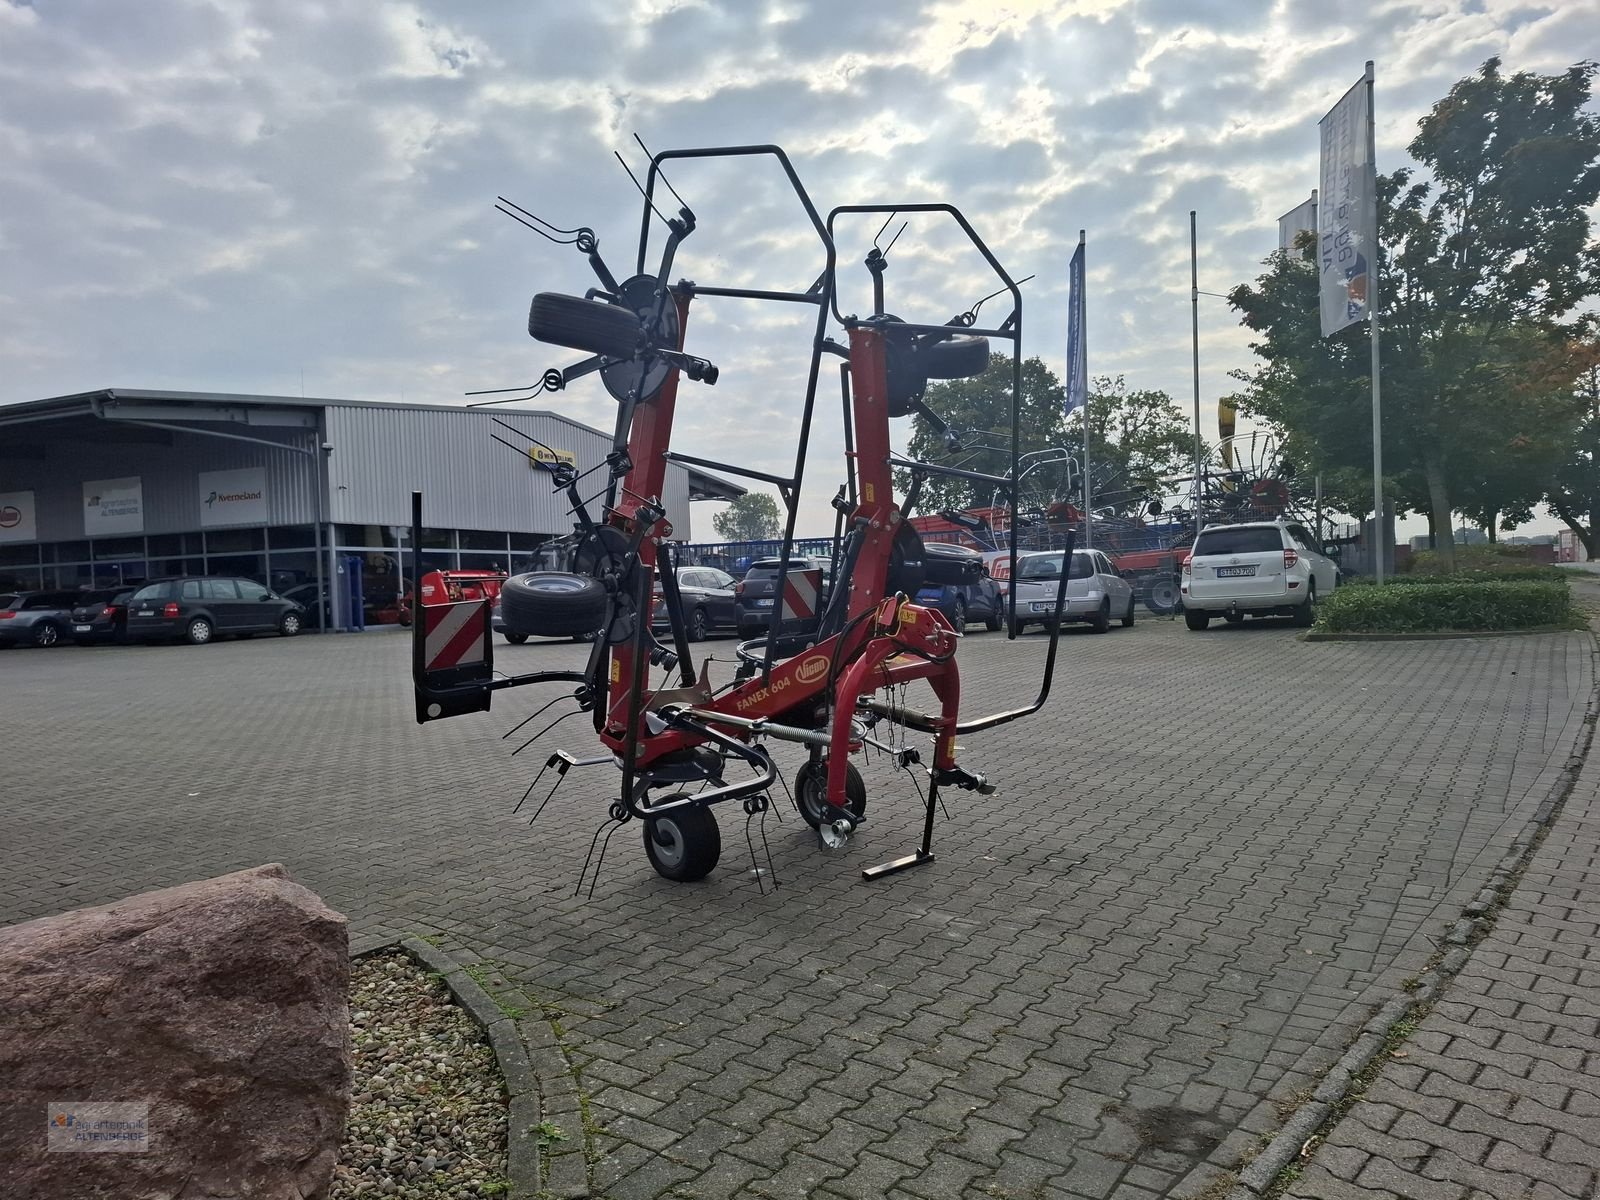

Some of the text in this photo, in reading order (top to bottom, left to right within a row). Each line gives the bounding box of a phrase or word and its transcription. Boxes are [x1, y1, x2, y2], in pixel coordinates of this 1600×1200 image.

[218, 491, 261, 502] Kverneland
[799, 659, 826, 680] Vicon
[736, 676, 791, 711] FANEX 604
